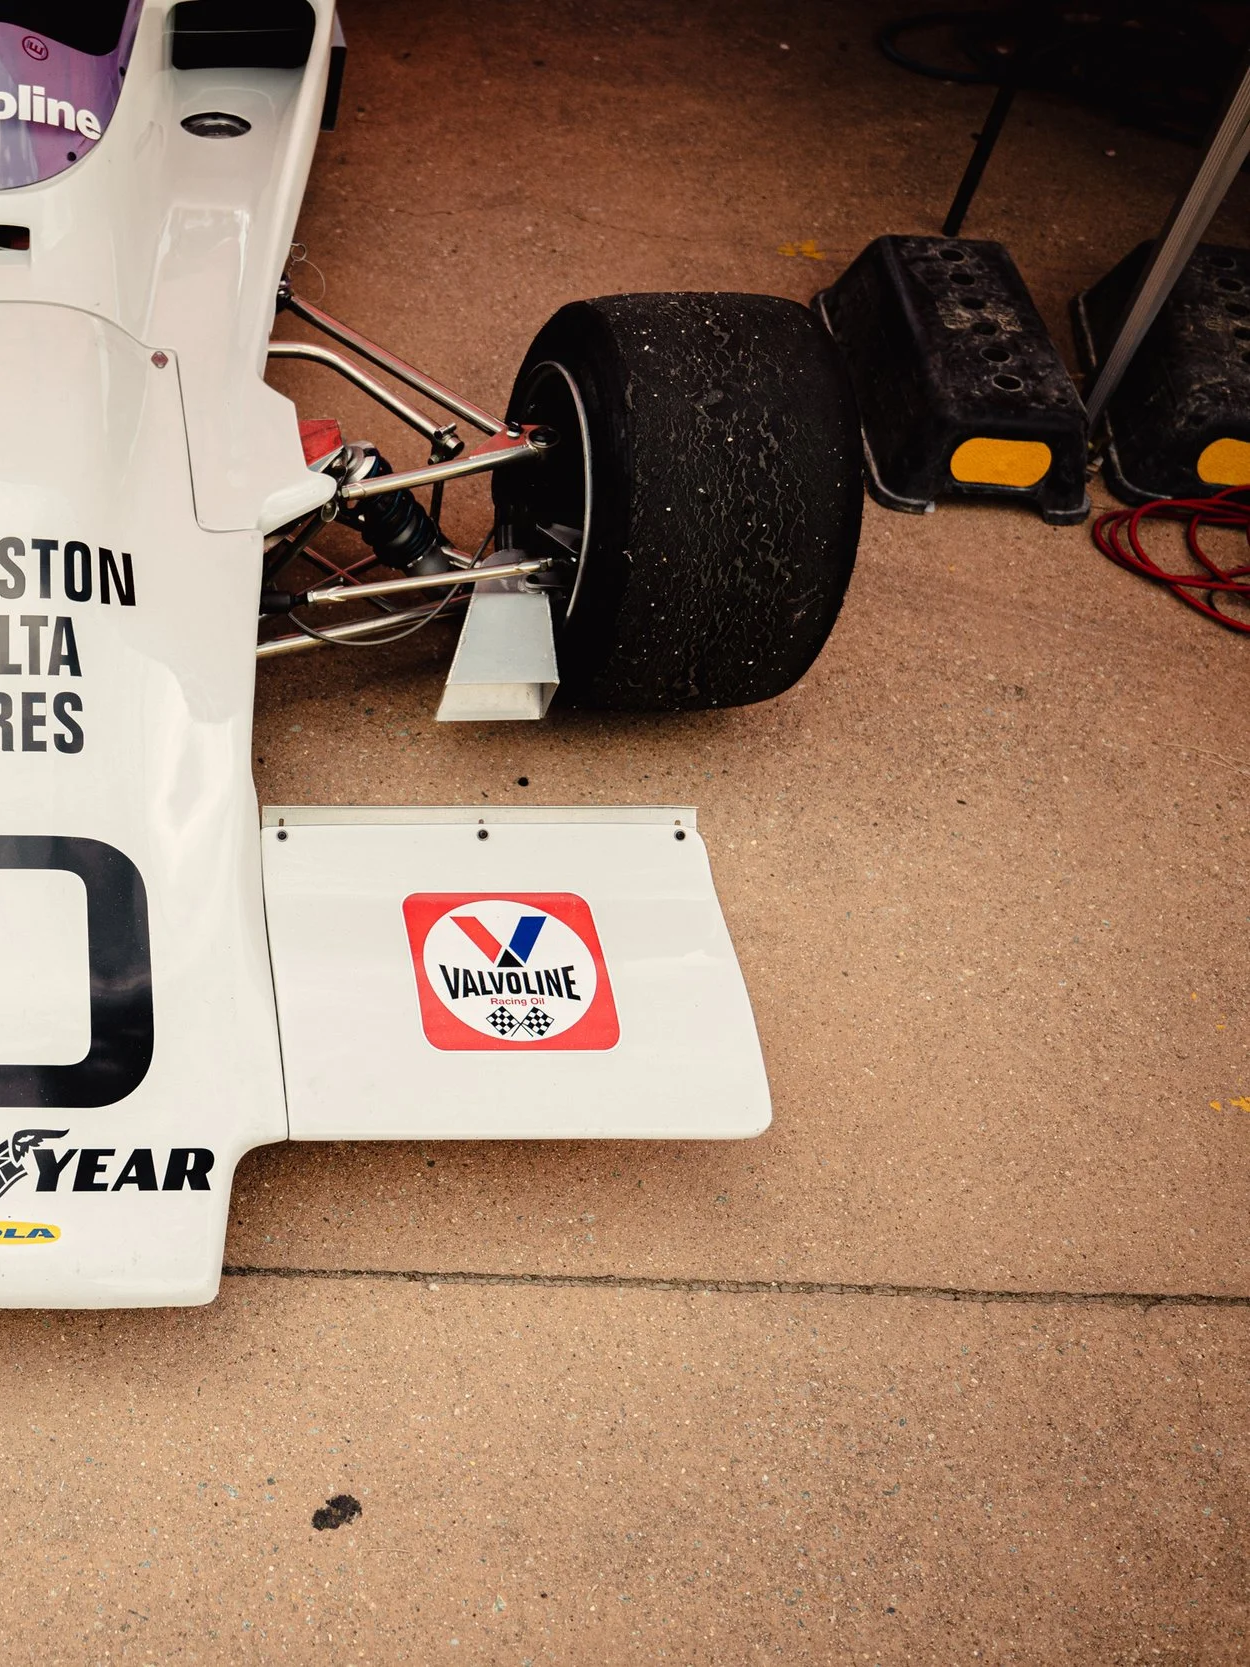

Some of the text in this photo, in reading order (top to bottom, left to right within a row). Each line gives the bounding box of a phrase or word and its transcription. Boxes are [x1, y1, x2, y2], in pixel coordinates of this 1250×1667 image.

[438, 963, 582, 1002] VALVOLINE
[490, 997, 546, 1007] Racing Oil
